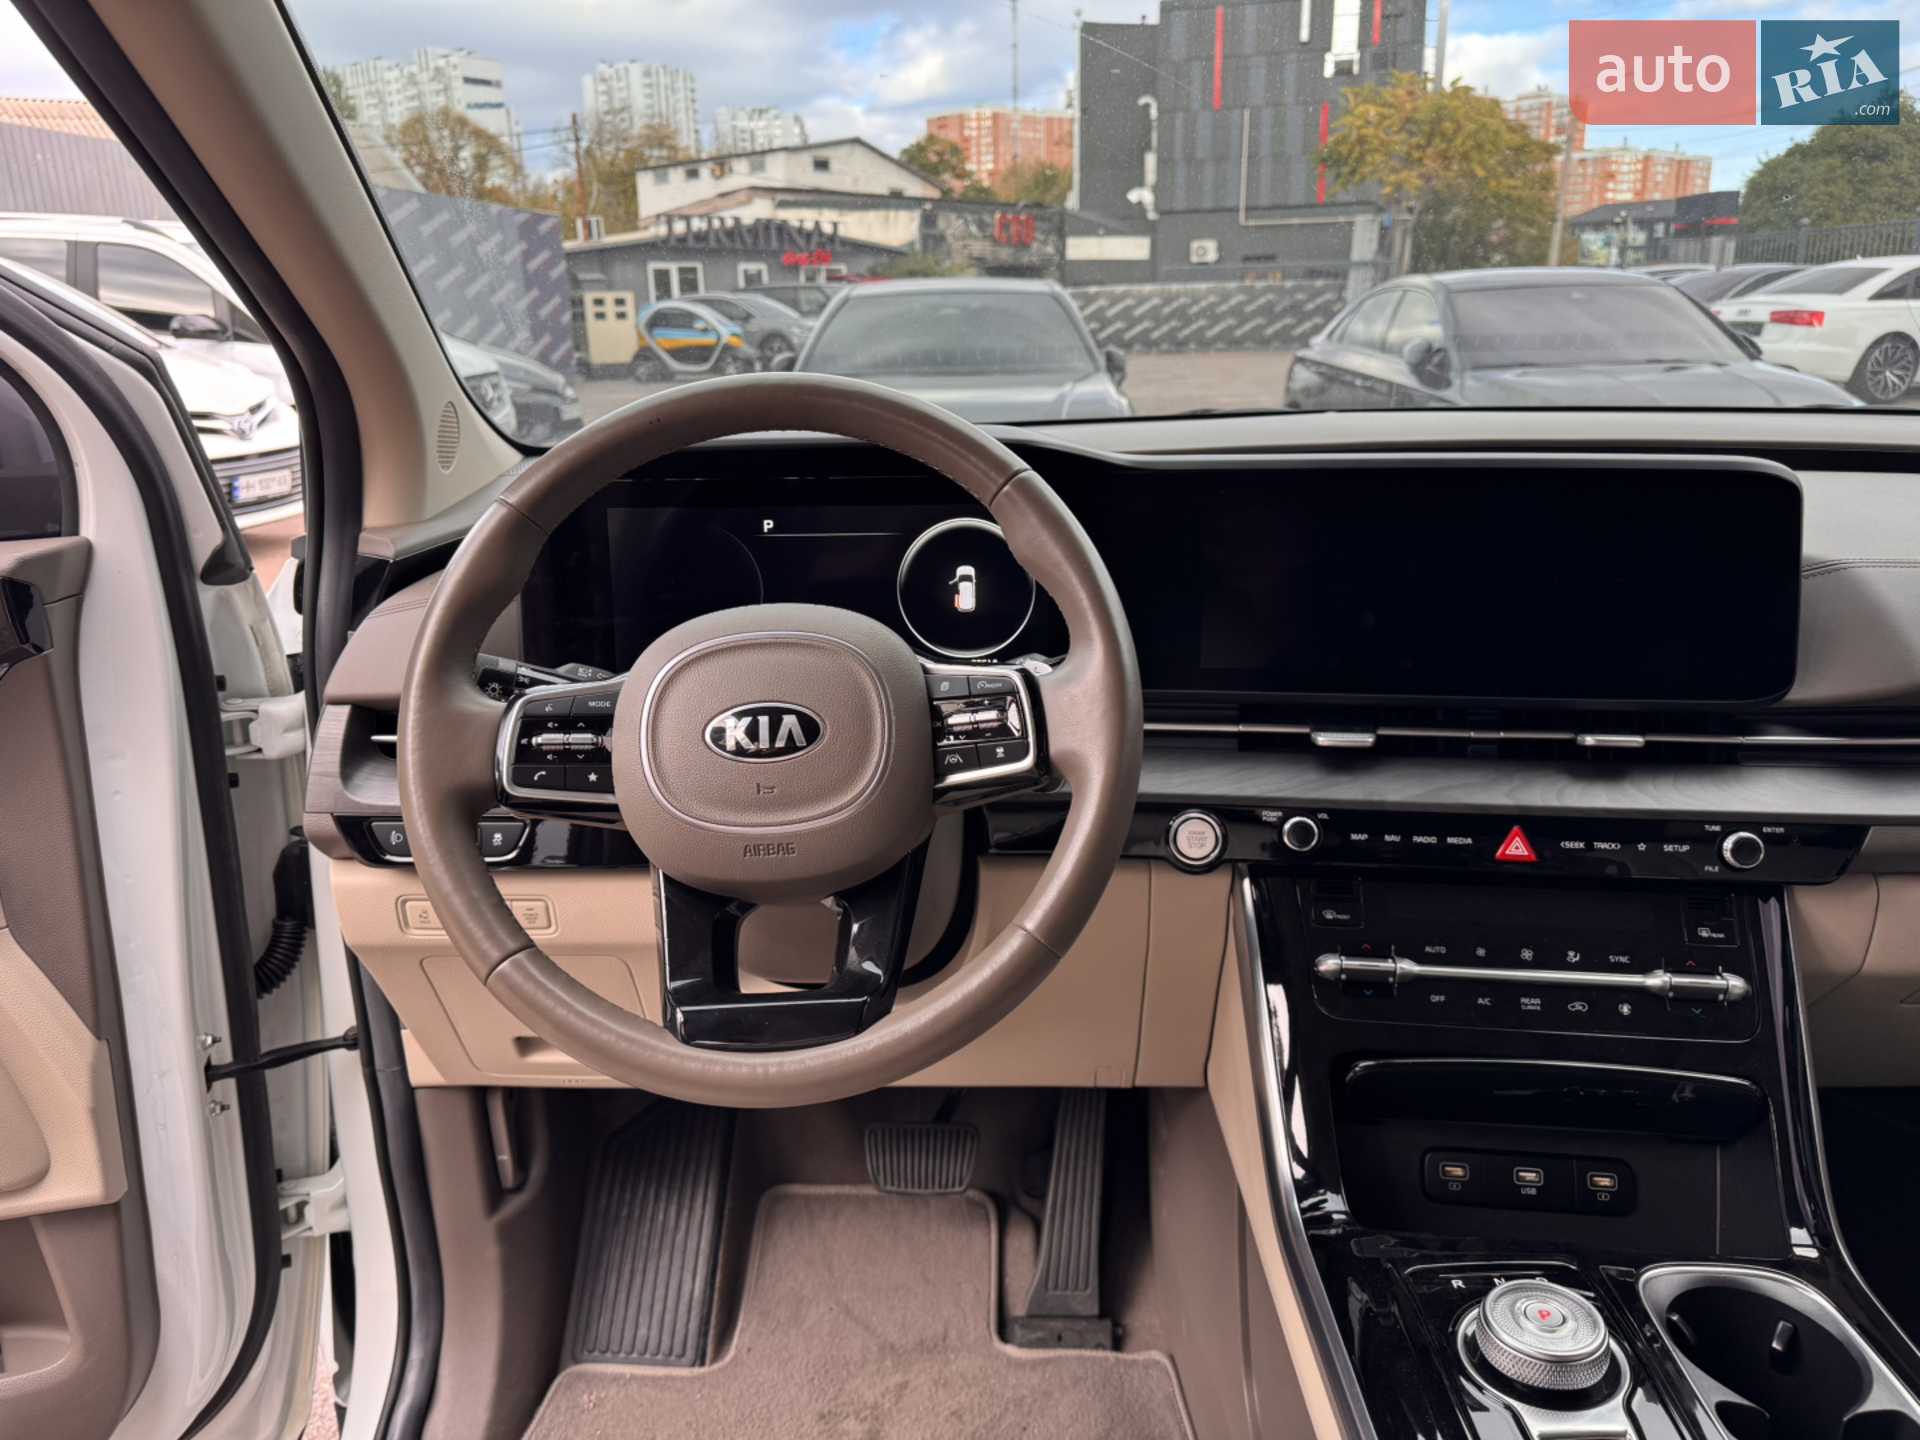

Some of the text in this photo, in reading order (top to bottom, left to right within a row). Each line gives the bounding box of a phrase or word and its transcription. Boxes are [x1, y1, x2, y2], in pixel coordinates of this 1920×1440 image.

[657, 213, 847, 251] TERMINAL
[763, 519, 774, 533] P
[724, 714, 807, 751] KIA
[1704, 824, 1722, 832] TUNE
[1762, 826, 1785, 834] ENTER
[1350, 833, 1369, 841] MAP
[1384, 834, 1401, 842] NAV
[1412, 835, 1437, 844] RADIO
[1446, 836, 1473, 845] MEDIA
[743, 842, 797, 858] AIRBAG
[1663, 844, 1690, 852] SETUP
[1704, 865, 1719, 873] FILE
[1424, 946, 1447, 954] AUTO
[1609, 955, 1631, 964] SYNC
[1430, 995, 1446, 1003] OFF
[1477, 997, 1492, 1006] A/C
[1520, 997, 1541, 1005] REAR
[1520, 1187, 1537, 1195] USB
[1451, 1279, 1466, 1289] R
[1537, 1309, 1552, 1321] P
